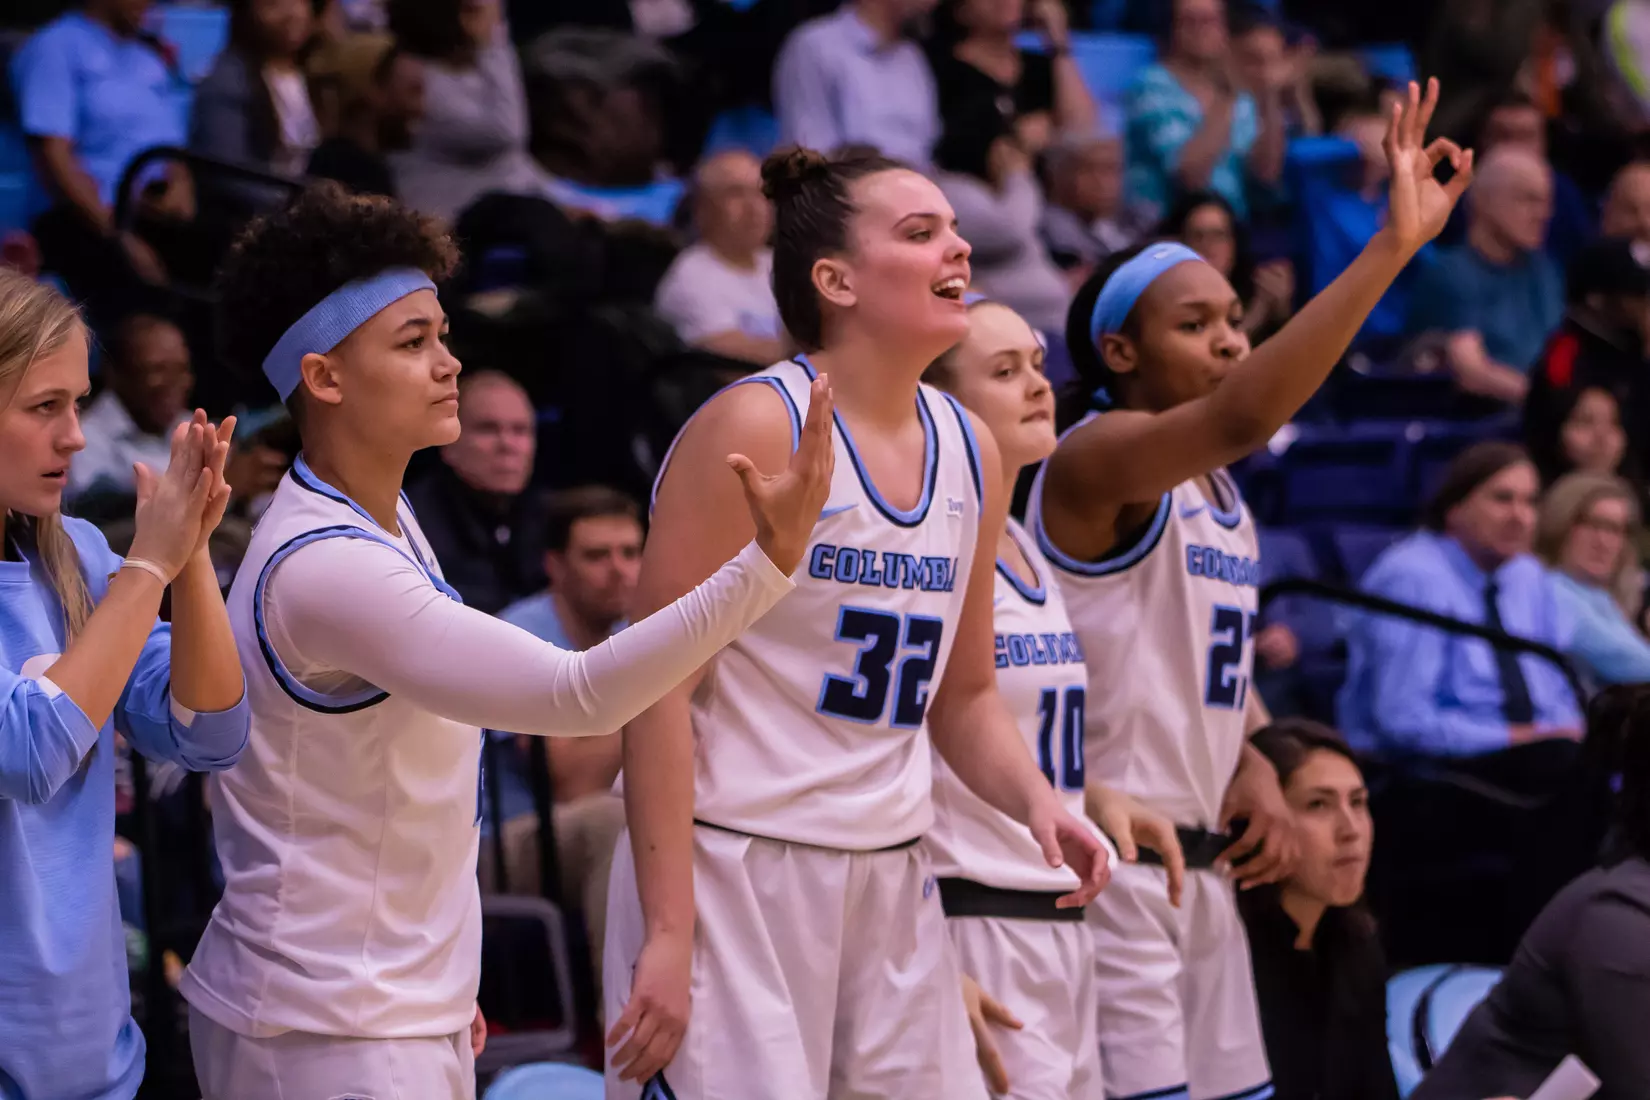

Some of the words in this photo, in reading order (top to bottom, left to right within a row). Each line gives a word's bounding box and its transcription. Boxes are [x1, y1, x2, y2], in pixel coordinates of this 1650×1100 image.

[815, 604, 943, 729] 32
[1204, 603, 1258, 711] 2
[1037, 686, 1085, 792] 10
